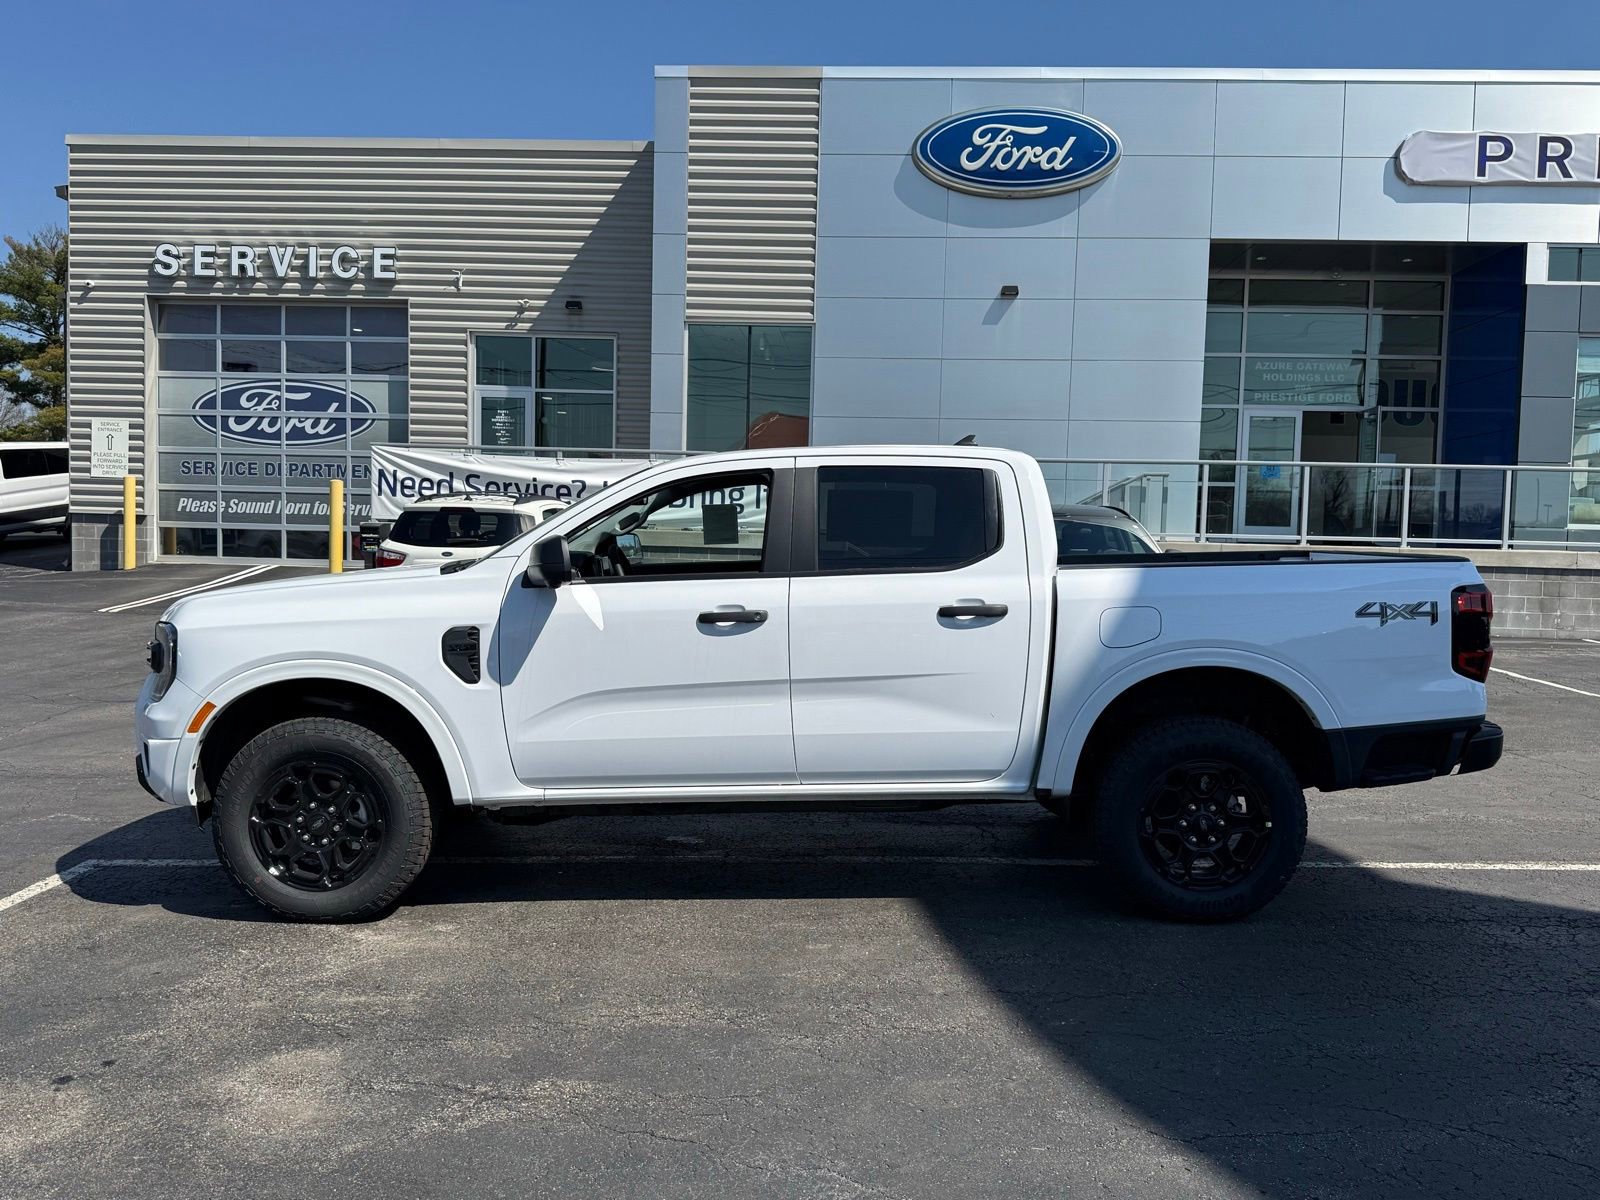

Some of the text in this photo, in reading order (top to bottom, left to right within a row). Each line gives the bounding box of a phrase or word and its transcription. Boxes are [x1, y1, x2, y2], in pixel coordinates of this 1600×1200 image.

[960, 123, 1077, 171] Ford
[1476, 135, 1600, 179] PR
[154, 243, 398, 279] SERVICE
[1255, 361, 1350, 371] AZURE GATEWAY
[1263, 373, 1345, 382] HOLDINGS LLC
[1254, 392, 1352, 402] PRESTIGE FORD
[227, 388, 340, 435] Ford
[180, 460, 372, 479] SERVICE DEPARTMEN
[377, 468, 454, 498] Need
[177, 497, 226, 513] Please
[228, 498, 275, 514] Sound
